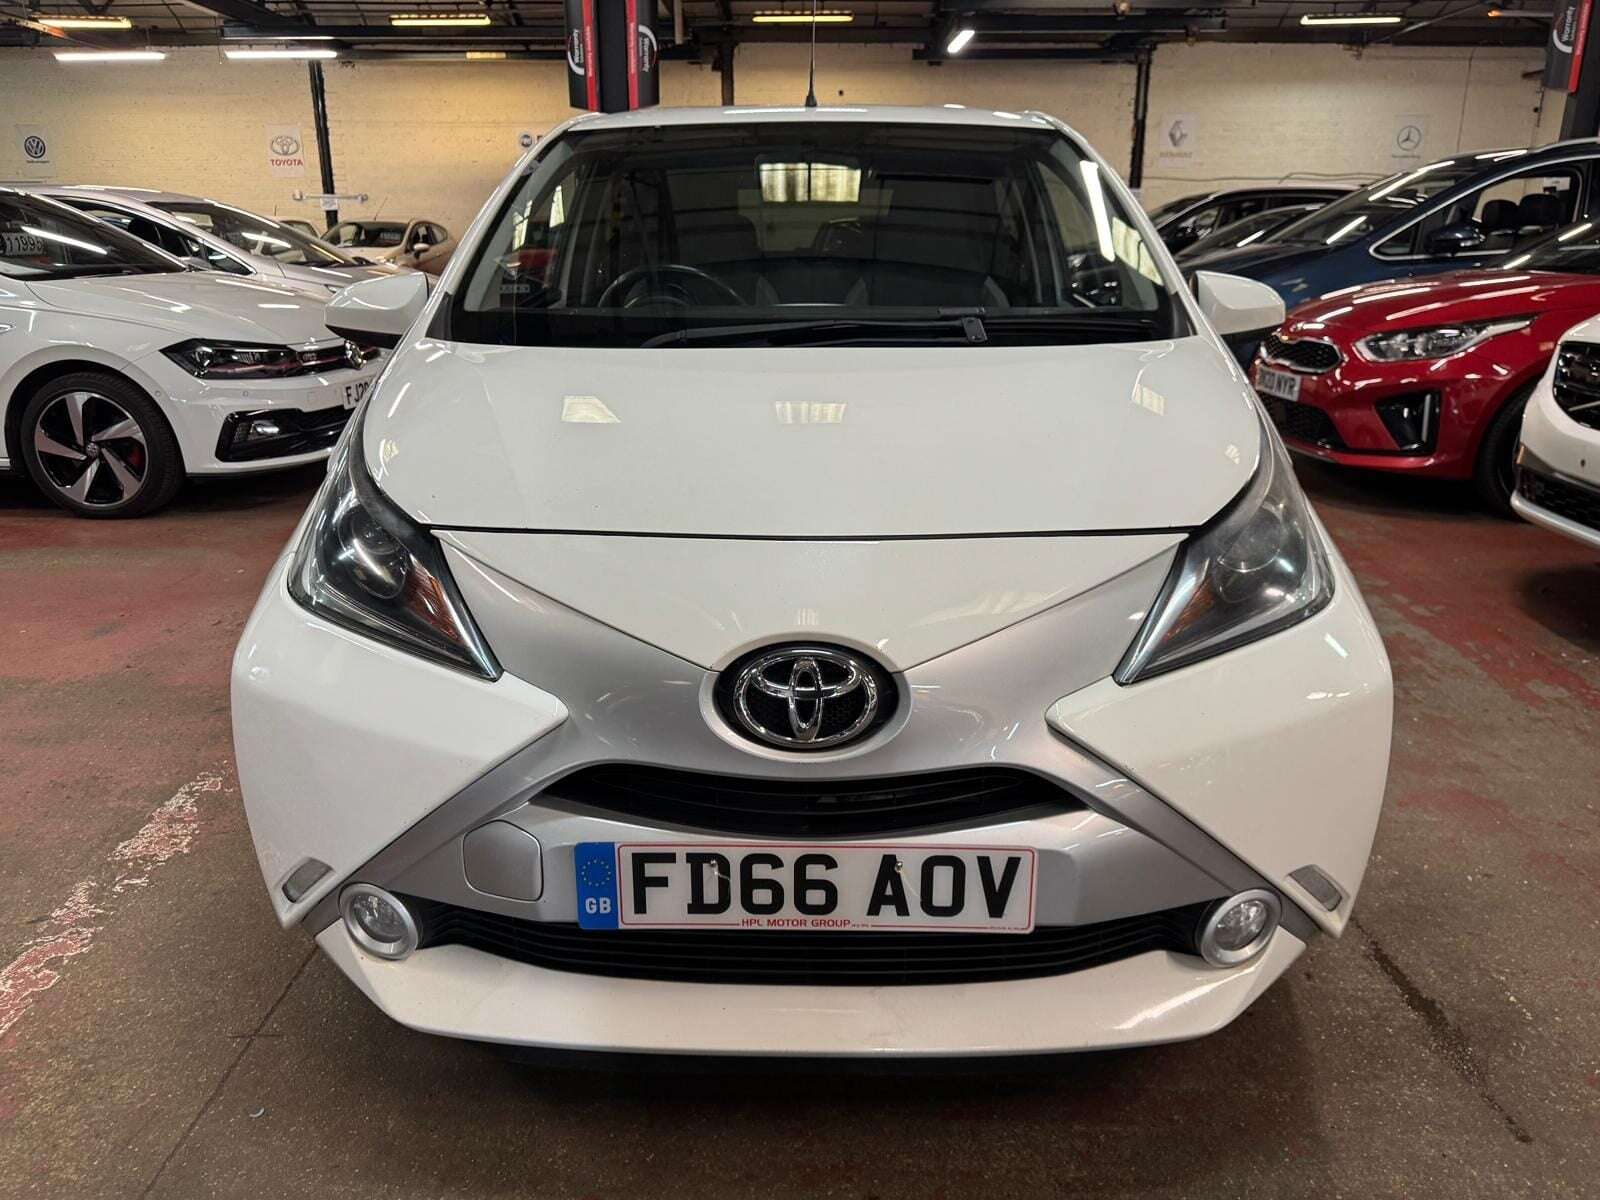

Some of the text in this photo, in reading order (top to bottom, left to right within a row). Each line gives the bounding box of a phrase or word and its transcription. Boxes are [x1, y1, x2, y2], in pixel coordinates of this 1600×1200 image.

[631, 852, 1022, 919] FD66 AOV
[585, 897, 612, 914] GB
[741, 918, 764, 928] HPL
[767, 918, 806, 928] MOTOR
[811, 918, 851, 928] GROUP
